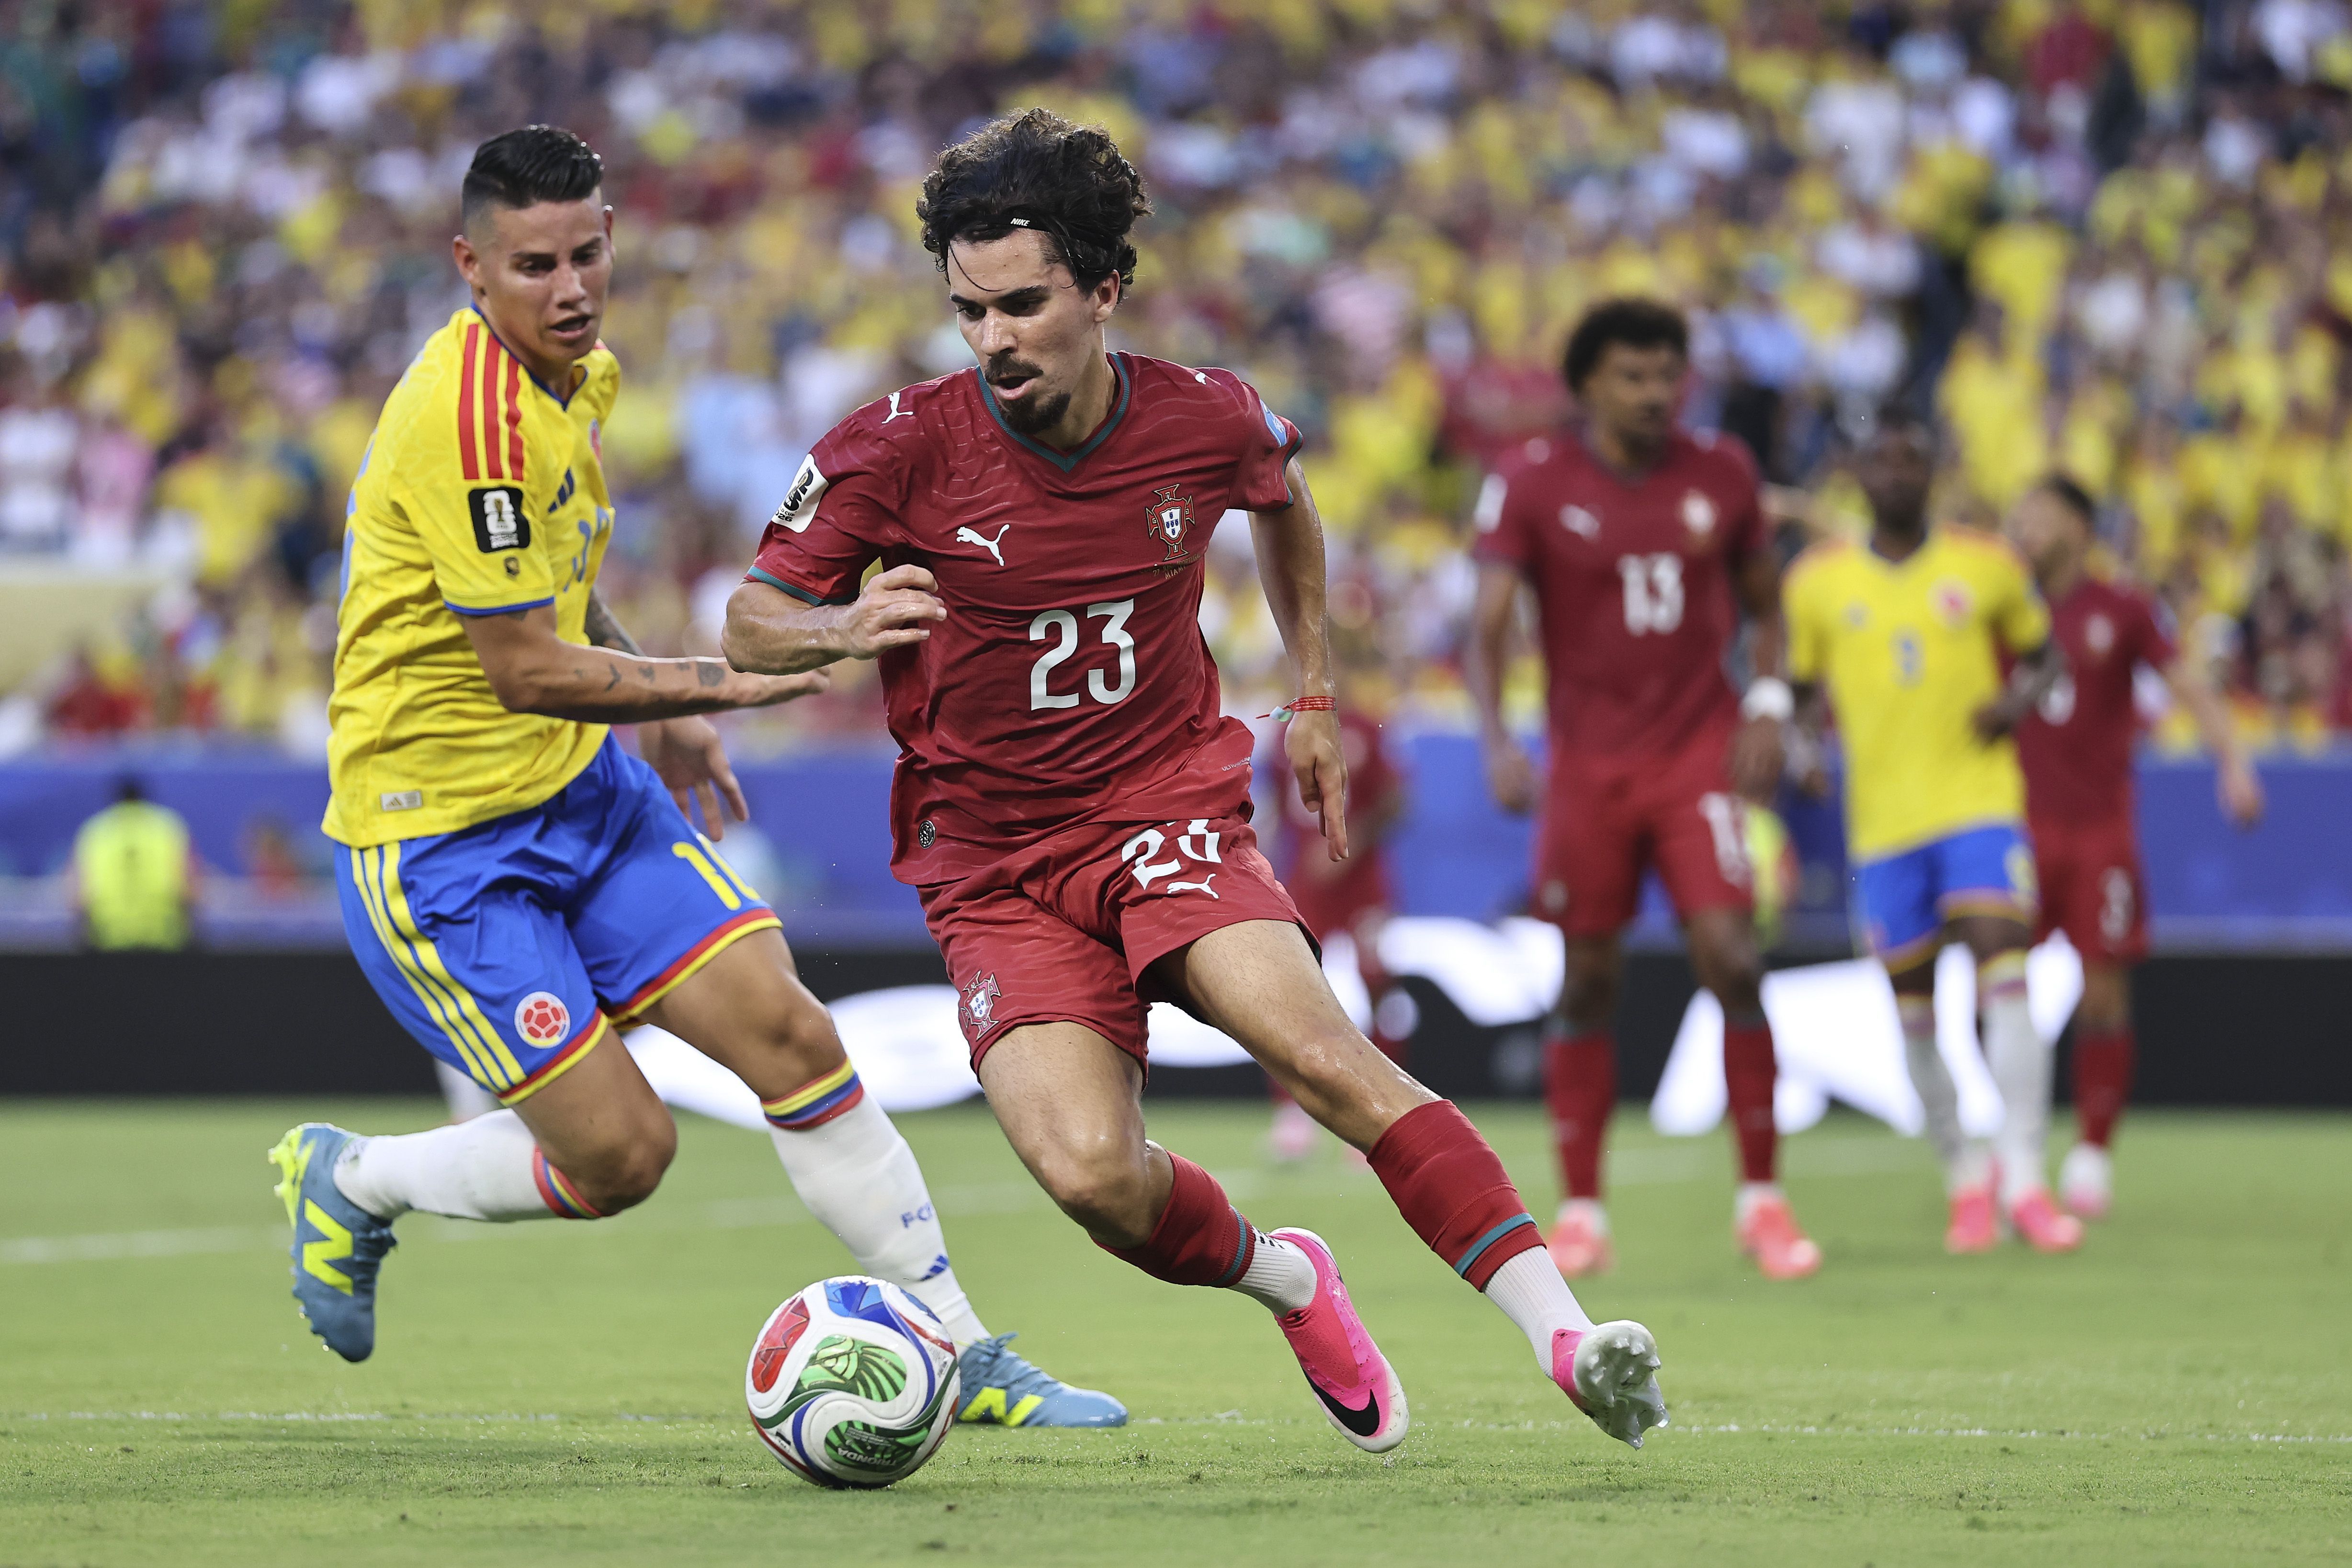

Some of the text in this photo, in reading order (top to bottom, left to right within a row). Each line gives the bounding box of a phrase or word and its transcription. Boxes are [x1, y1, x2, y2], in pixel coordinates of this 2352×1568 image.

[1010, 218, 1030, 226] NIKE
[1165, 564, 1186, 579] MIAMI
[1617, 553, 1685, 637] 13
[1029, 598, 1136, 711] 23
[838, 1447, 896, 1466] TRIONDA
